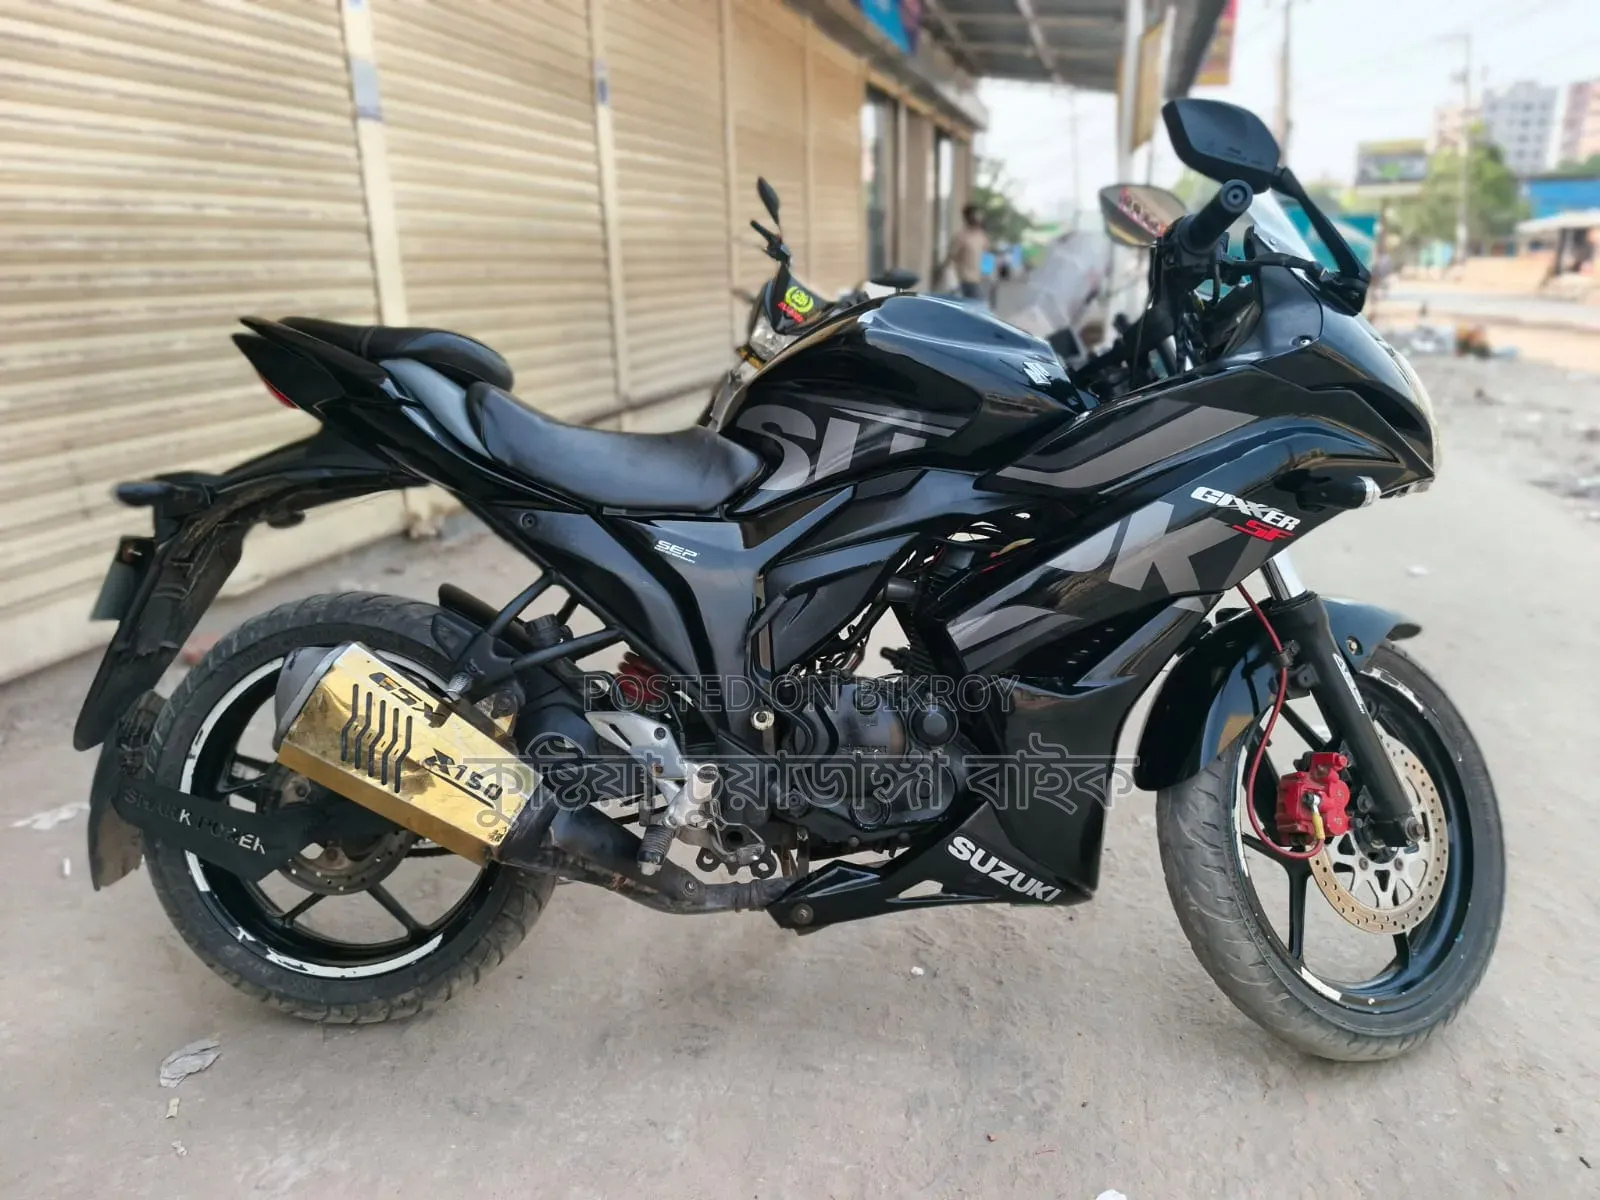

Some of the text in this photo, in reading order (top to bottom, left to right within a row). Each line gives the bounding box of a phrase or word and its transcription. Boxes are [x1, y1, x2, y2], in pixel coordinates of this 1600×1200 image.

[1190, 486, 1301, 531] GIXXER
[1232, 519, 1295, 542] SF
[654, 540, 698, 557] SEP
[947, 836, 1062, 902] SUZUKI
